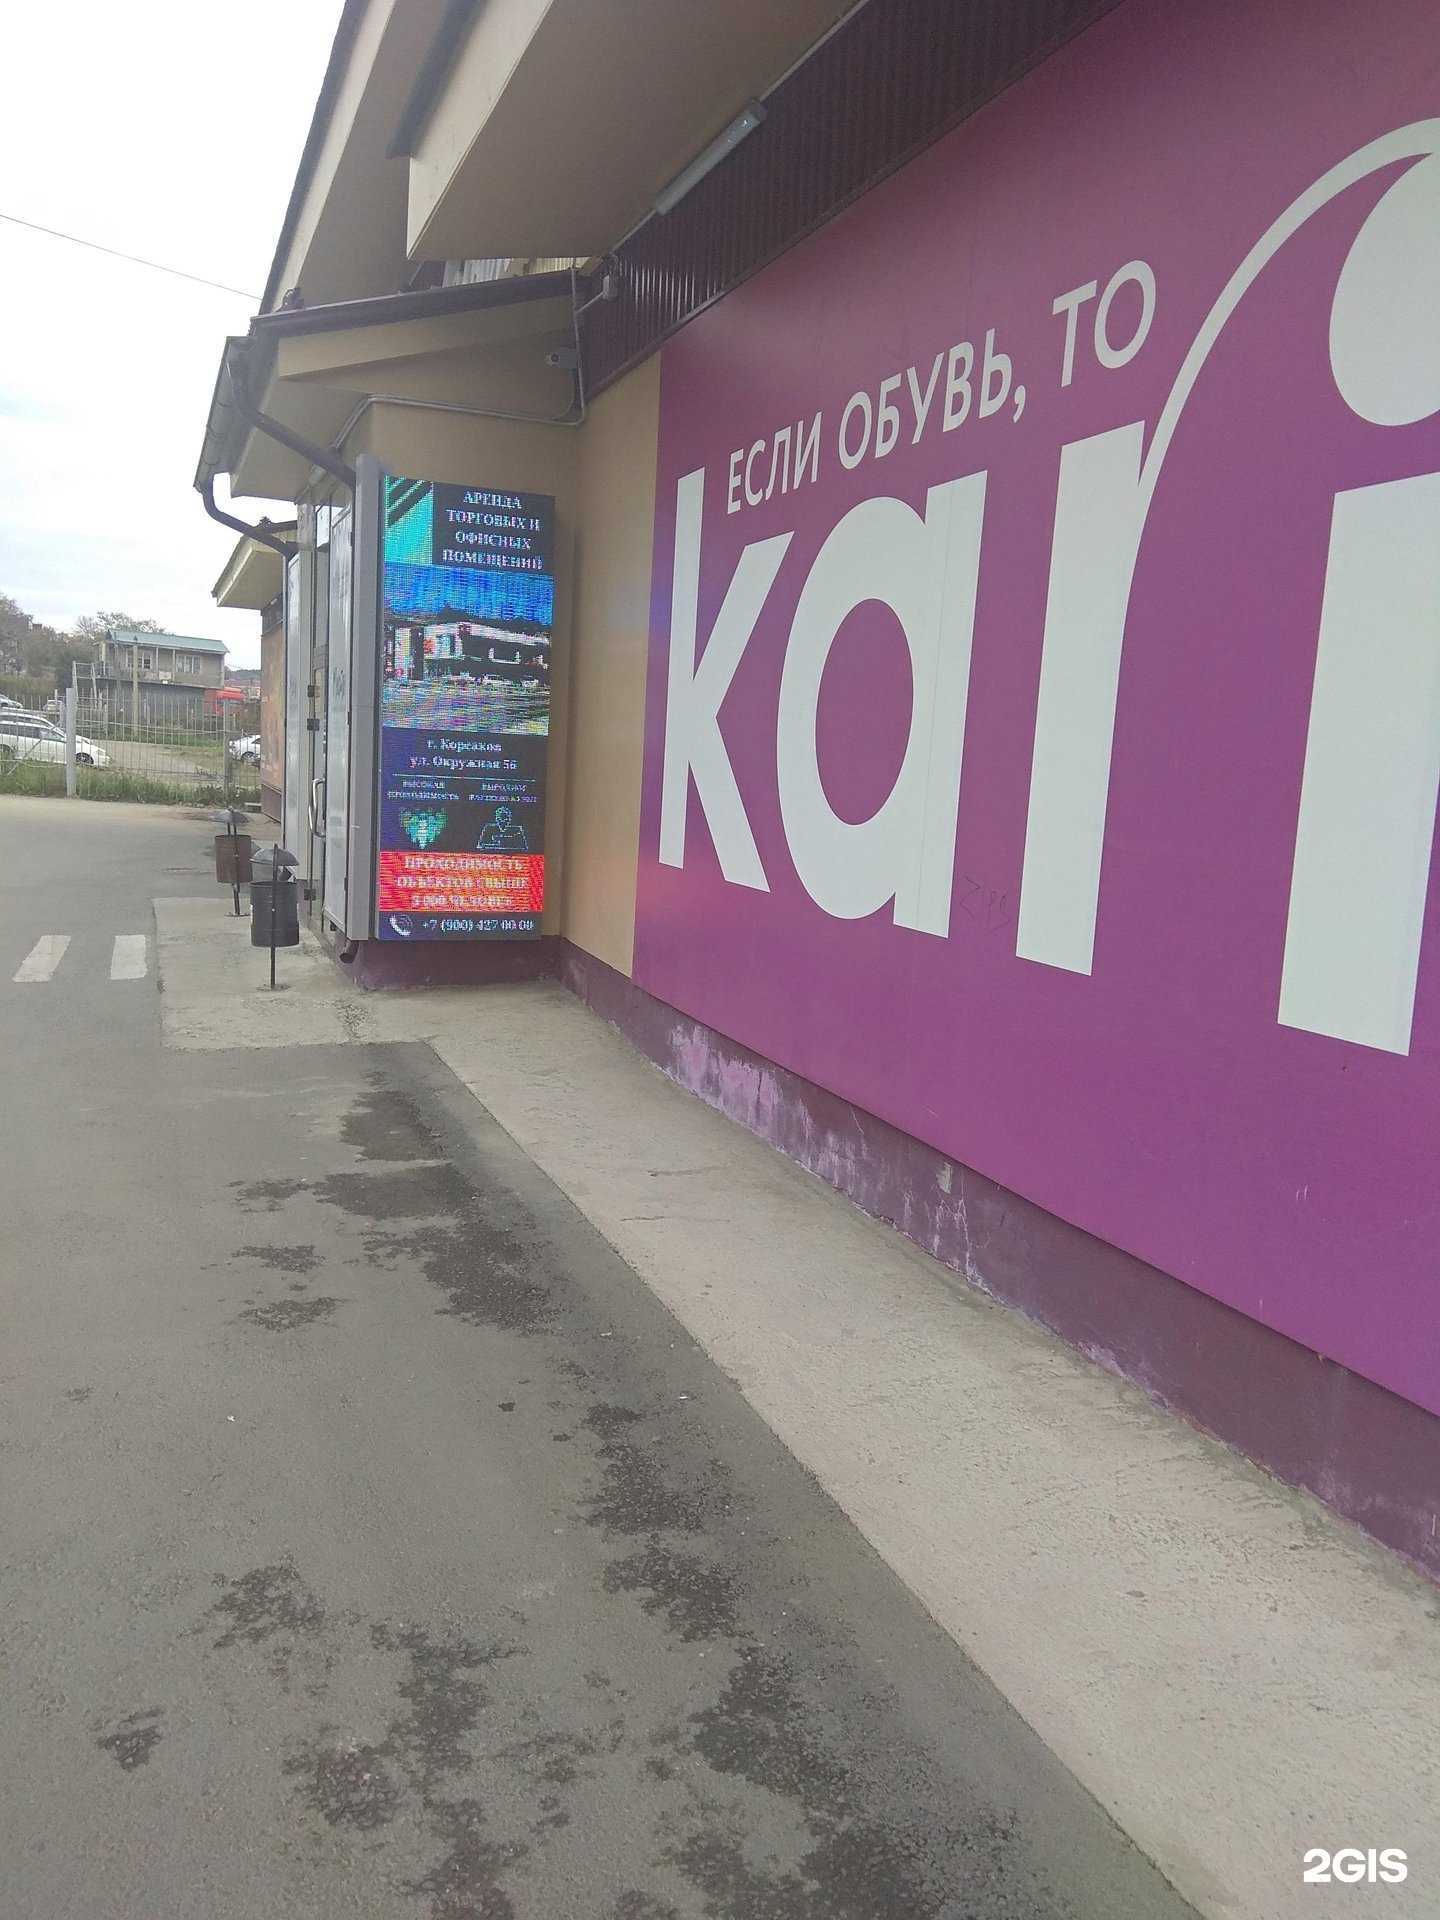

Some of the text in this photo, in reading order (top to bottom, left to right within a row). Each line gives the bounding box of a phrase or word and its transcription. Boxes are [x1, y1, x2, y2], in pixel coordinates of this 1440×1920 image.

[726, 259, 1157, 514] ЕСЛИ ОБУВЬ, ТО
[463, 491, 523, 509] АРЕНДА
[446, 509, 526, 530] ТОРГОВЫХ
[455, 530, 531, 550] ОФИСНЫХ
[658, 117, 1440, 1057] kari
[440, 738, 502, 752] Корсаков
[433, 756, 501, 770] Окружная
